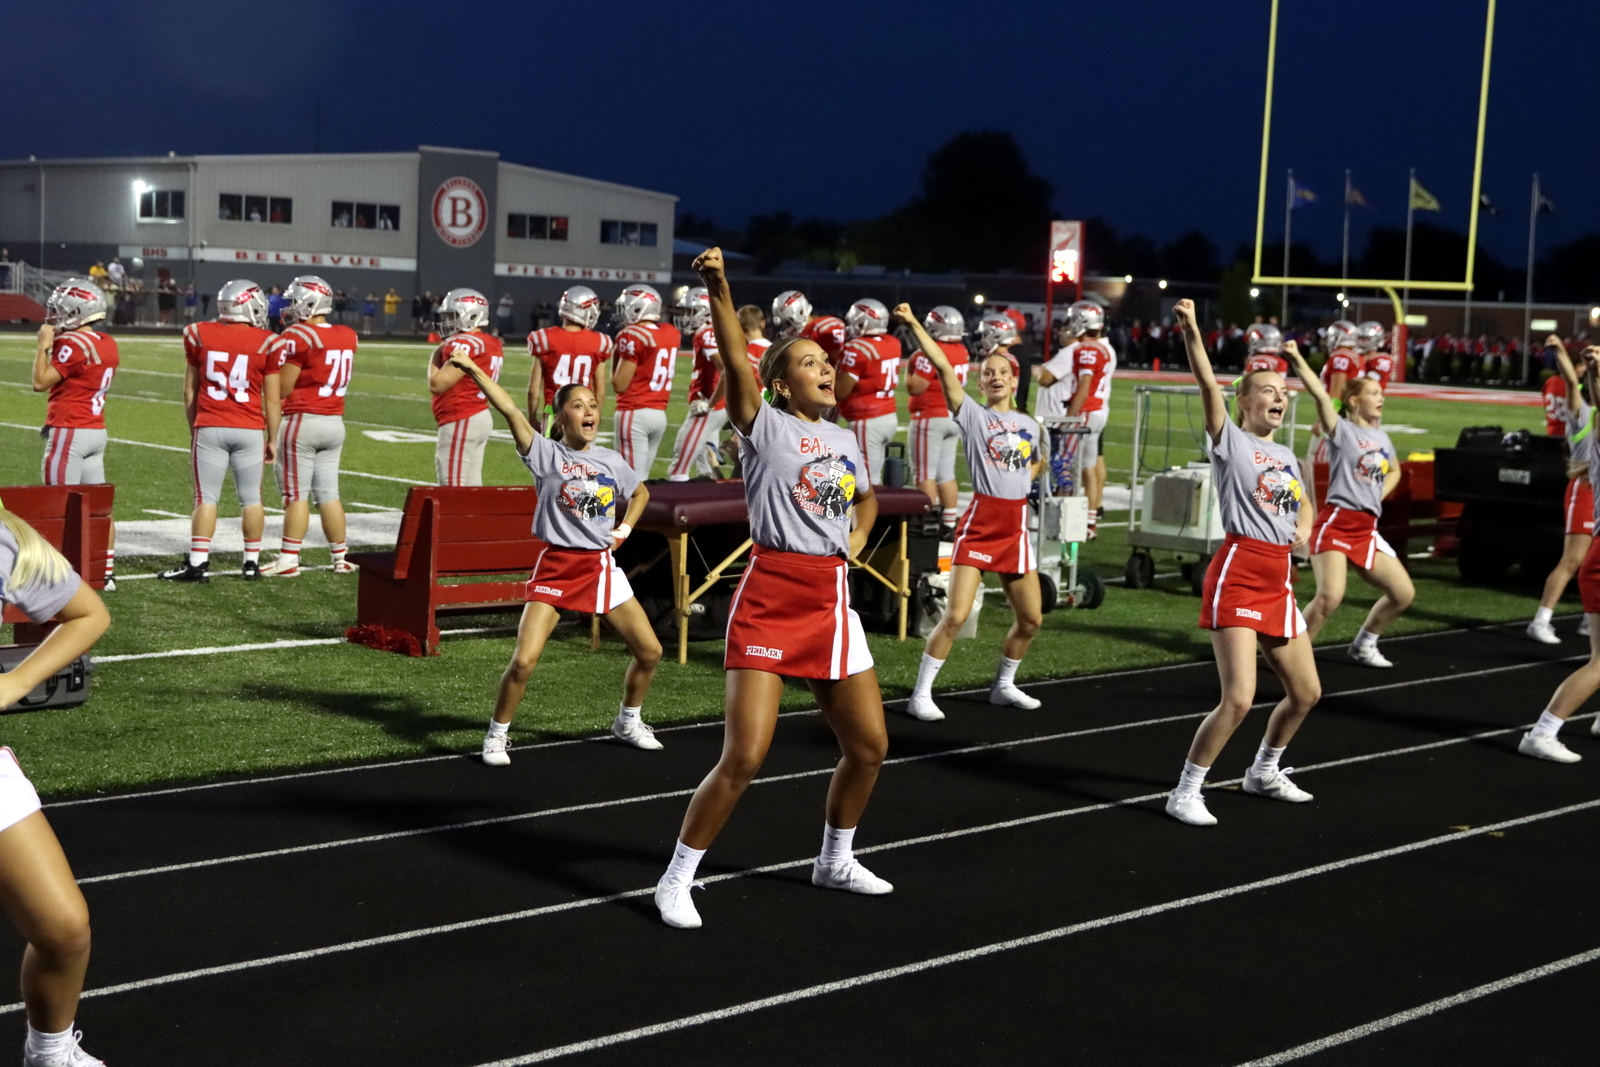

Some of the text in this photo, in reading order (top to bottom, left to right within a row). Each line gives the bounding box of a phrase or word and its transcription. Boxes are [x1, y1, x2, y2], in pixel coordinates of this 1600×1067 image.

[447, 196, 473, 229] B
[235, 251, 381, 267] BELLEVUE
[507, 265, 656, 281] FIELDHOUSE
[58, 345, 73, 363] 8
[619, 338, 635, 355] 64
[842, 350, 857, 367] 75
[916, 356, 932, 373] 65
[1079, 350, 1097, 364] 25
[206, 350, 249, 402] 54
[318, 349, 353, 397] 70
[553, 354, 592, 387] 40
[91, 367, 113, 415] 8
[745, 645, 783, 660] REDMEN
